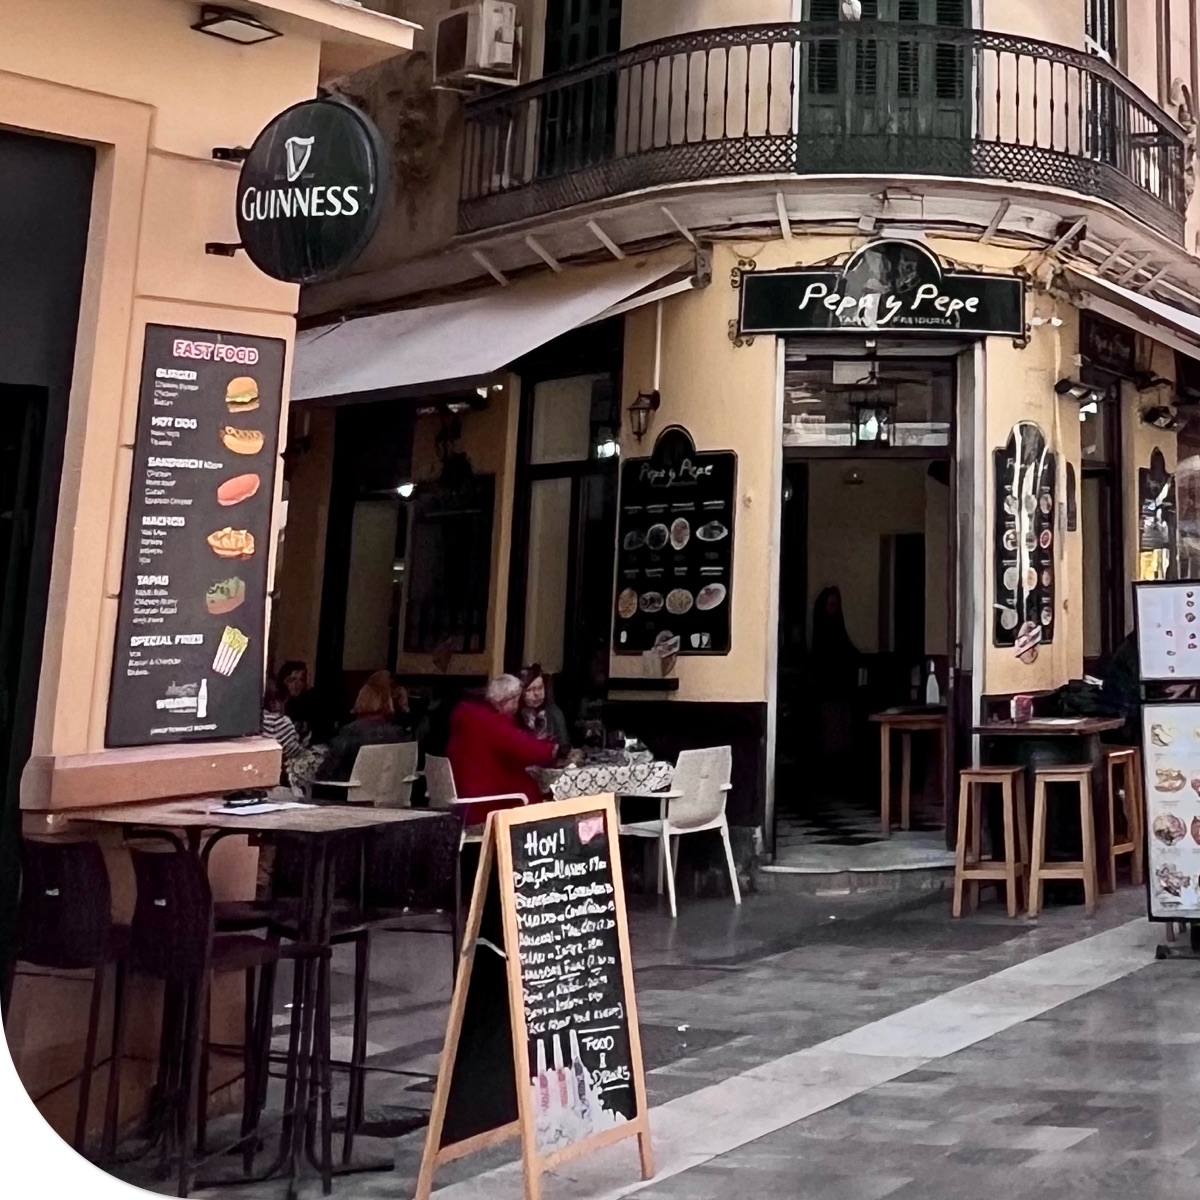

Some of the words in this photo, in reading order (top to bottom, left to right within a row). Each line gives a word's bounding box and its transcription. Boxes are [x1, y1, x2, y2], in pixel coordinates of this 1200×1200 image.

[241, 186, 360, 221] GUINNESS
[877, 294, 903, 325] y
[910, 283, 979, 318] Pepe
[173, 339, 214, 360] FAST
[213, 343, 259, 364] FOOD
[581, 1035, 614, 1051] FOOD
